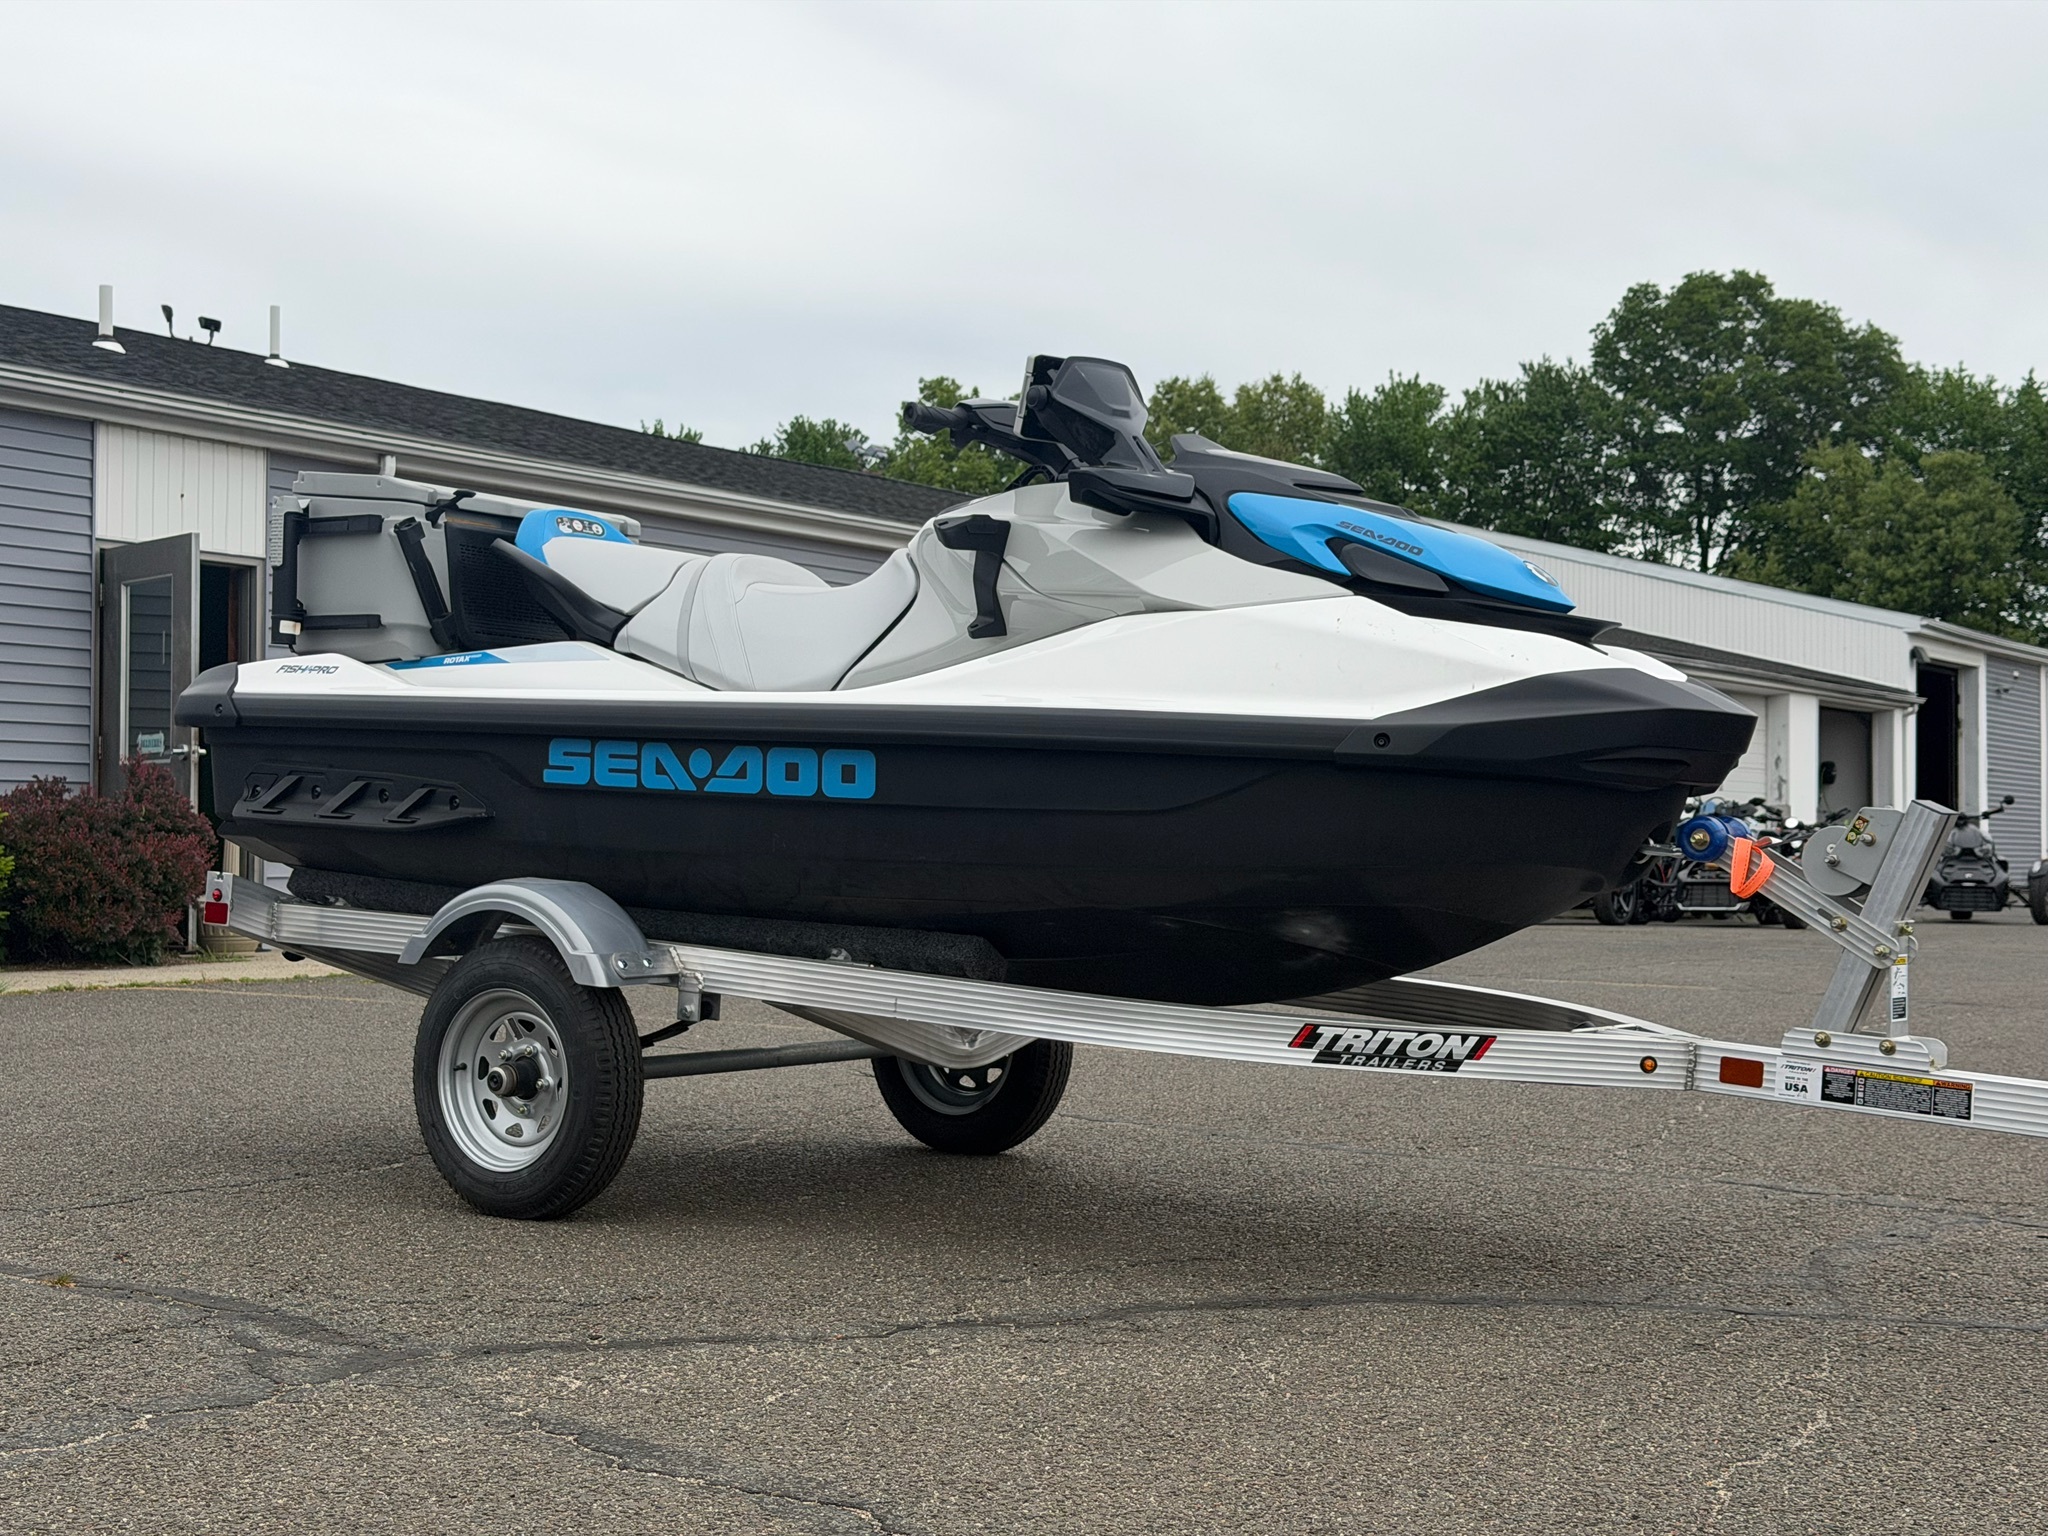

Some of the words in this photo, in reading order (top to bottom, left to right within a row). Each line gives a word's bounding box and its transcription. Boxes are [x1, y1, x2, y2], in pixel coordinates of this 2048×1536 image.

[443, 655, 471, 665] ROTAX
[1312, 1025, 1480, 1060] TRITON
[1339, 1054, 1447, 1071] TRAILERS
[1784, 1064, 1813, 1073] TRITON
[1831, 1067, 1856, 1076] DANGER
[1785, 1082, 1809, 1094] USA
